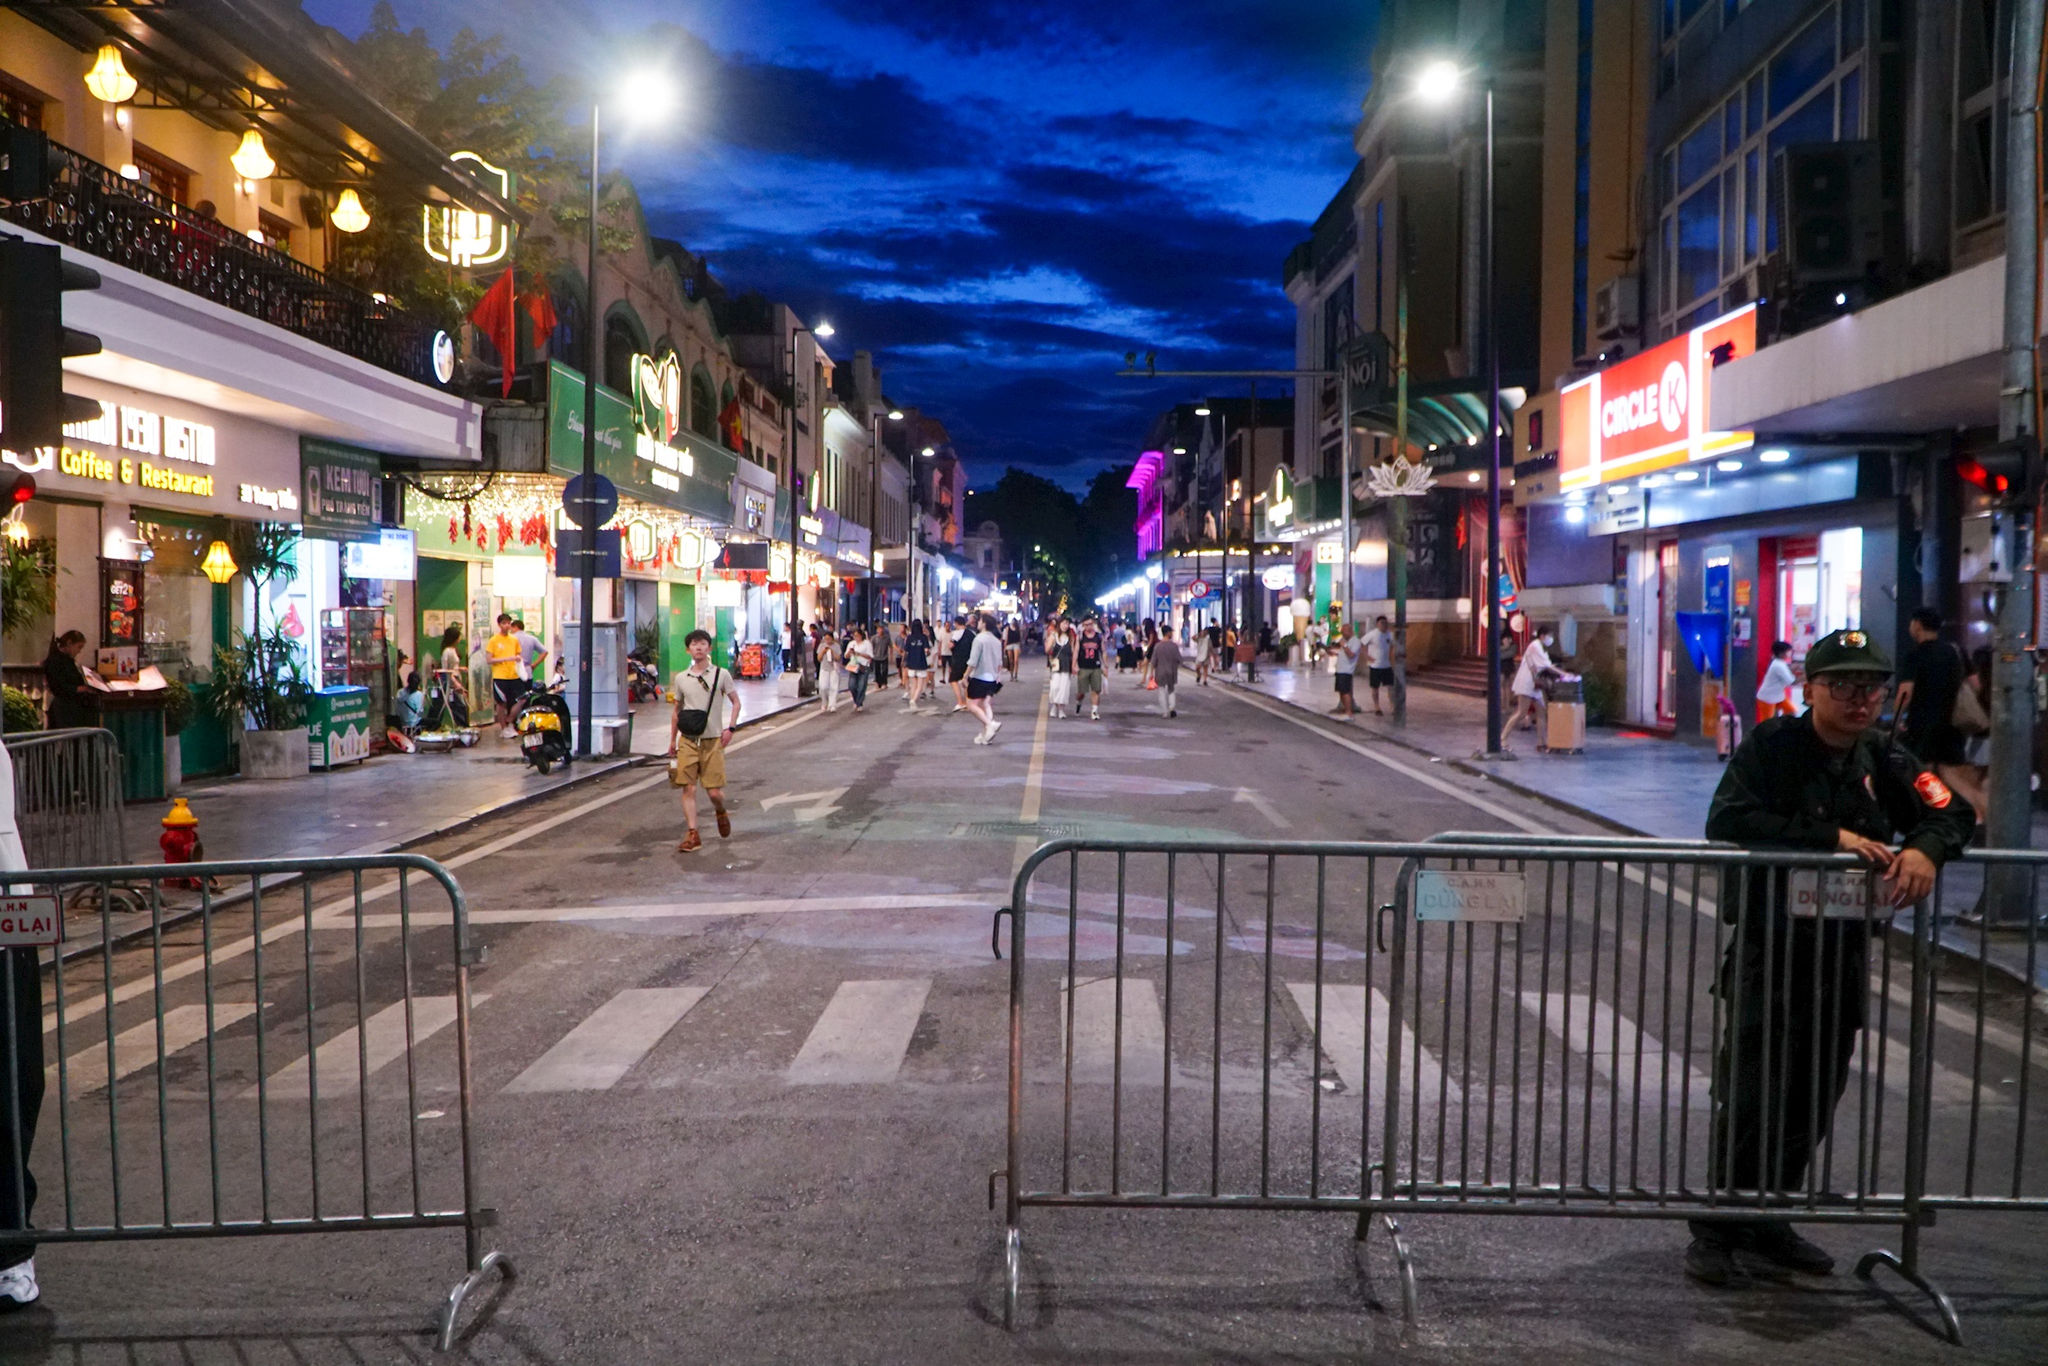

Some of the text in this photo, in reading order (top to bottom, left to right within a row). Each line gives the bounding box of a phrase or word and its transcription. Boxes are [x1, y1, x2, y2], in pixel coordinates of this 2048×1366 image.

[121, 405, 160, 455] 1930
[1602, 383, 1658, 438] CIRCLE
[61, 447, 214, 497] Coffee & Restaurant
[326, 463, 351, 493] KEM
